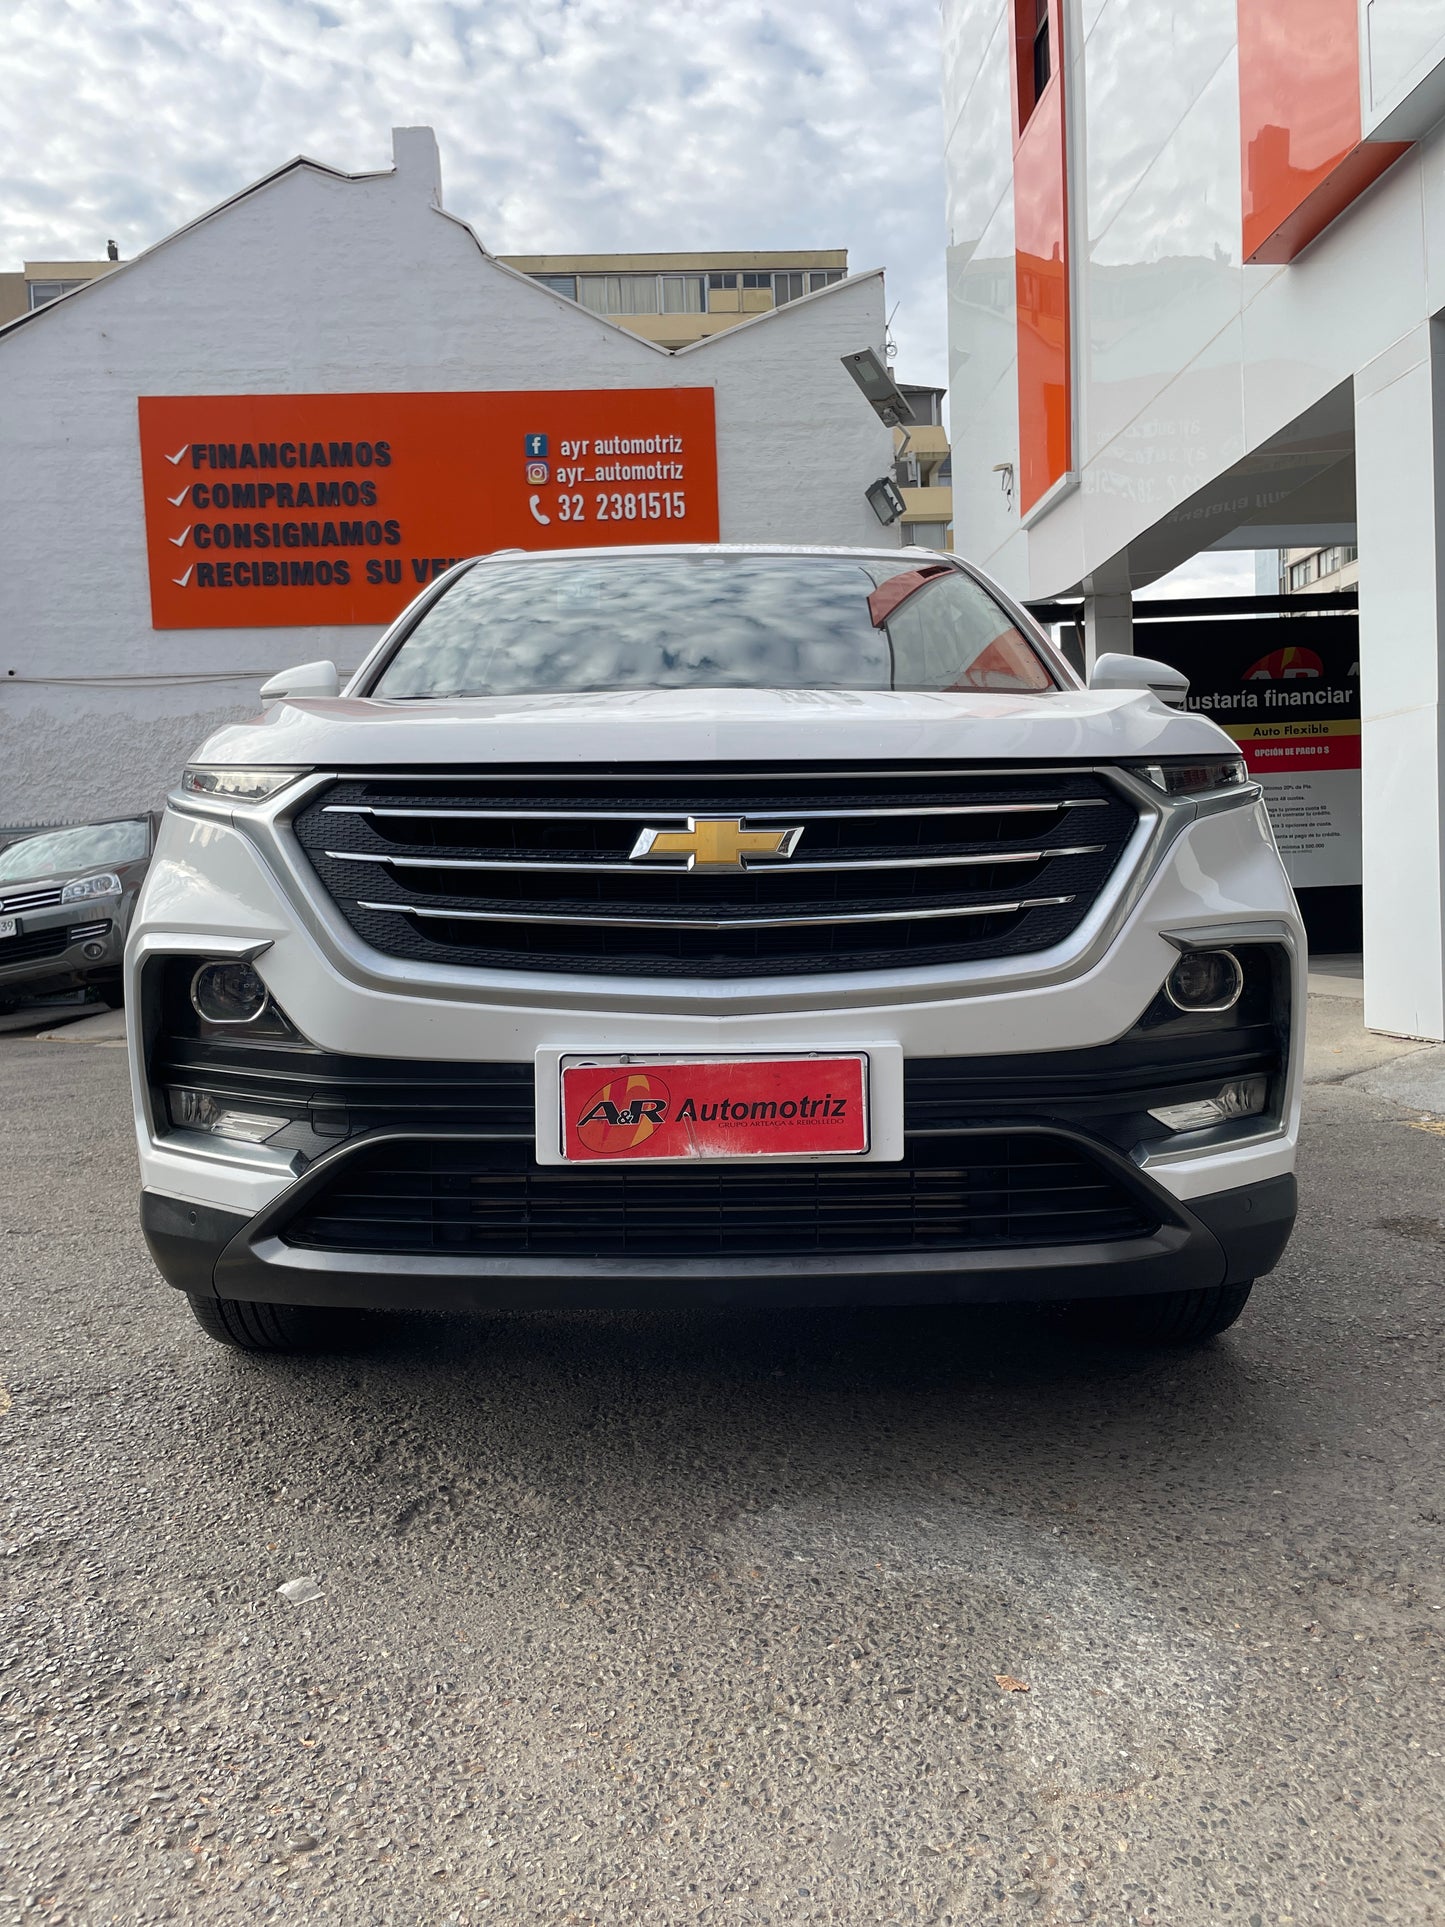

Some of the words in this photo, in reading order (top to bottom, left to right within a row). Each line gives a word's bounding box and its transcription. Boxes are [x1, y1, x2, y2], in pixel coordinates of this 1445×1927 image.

[191, 441, 392, 469] FINANCIAMOS
[560, 440, 589, 460] ayr
[594, 434, 682, 455] automotriz
[556, 461, 684, 488] ayr_automotriz
[192, 480, 378, 508] COMPRAMOS
[558, 494, 585, 521] 32
[596, 492, 686, 520] 2381515
[194, 519, 401, 548] CONSIGNAMOS
[196, 560, 350, 588] RECIBIMOS
[366, 559, 401, 585] SU
[1264, 686, 1353, 707] financiar
[1253, 727, 1280, 737] Auto
[1284, 724, 1330, 735] Flexible
[1254, 746, 1284, 757] OPCIÓN
[1285, 748, 1294, 756] DE
[1296, 747, 1316, 755] PAGO
[576, 1099, 669, 1127] A&R
[675, 1094, 848, 1122] Automotriz
[796, 1118, 844, 1126] REBOLLEDO
